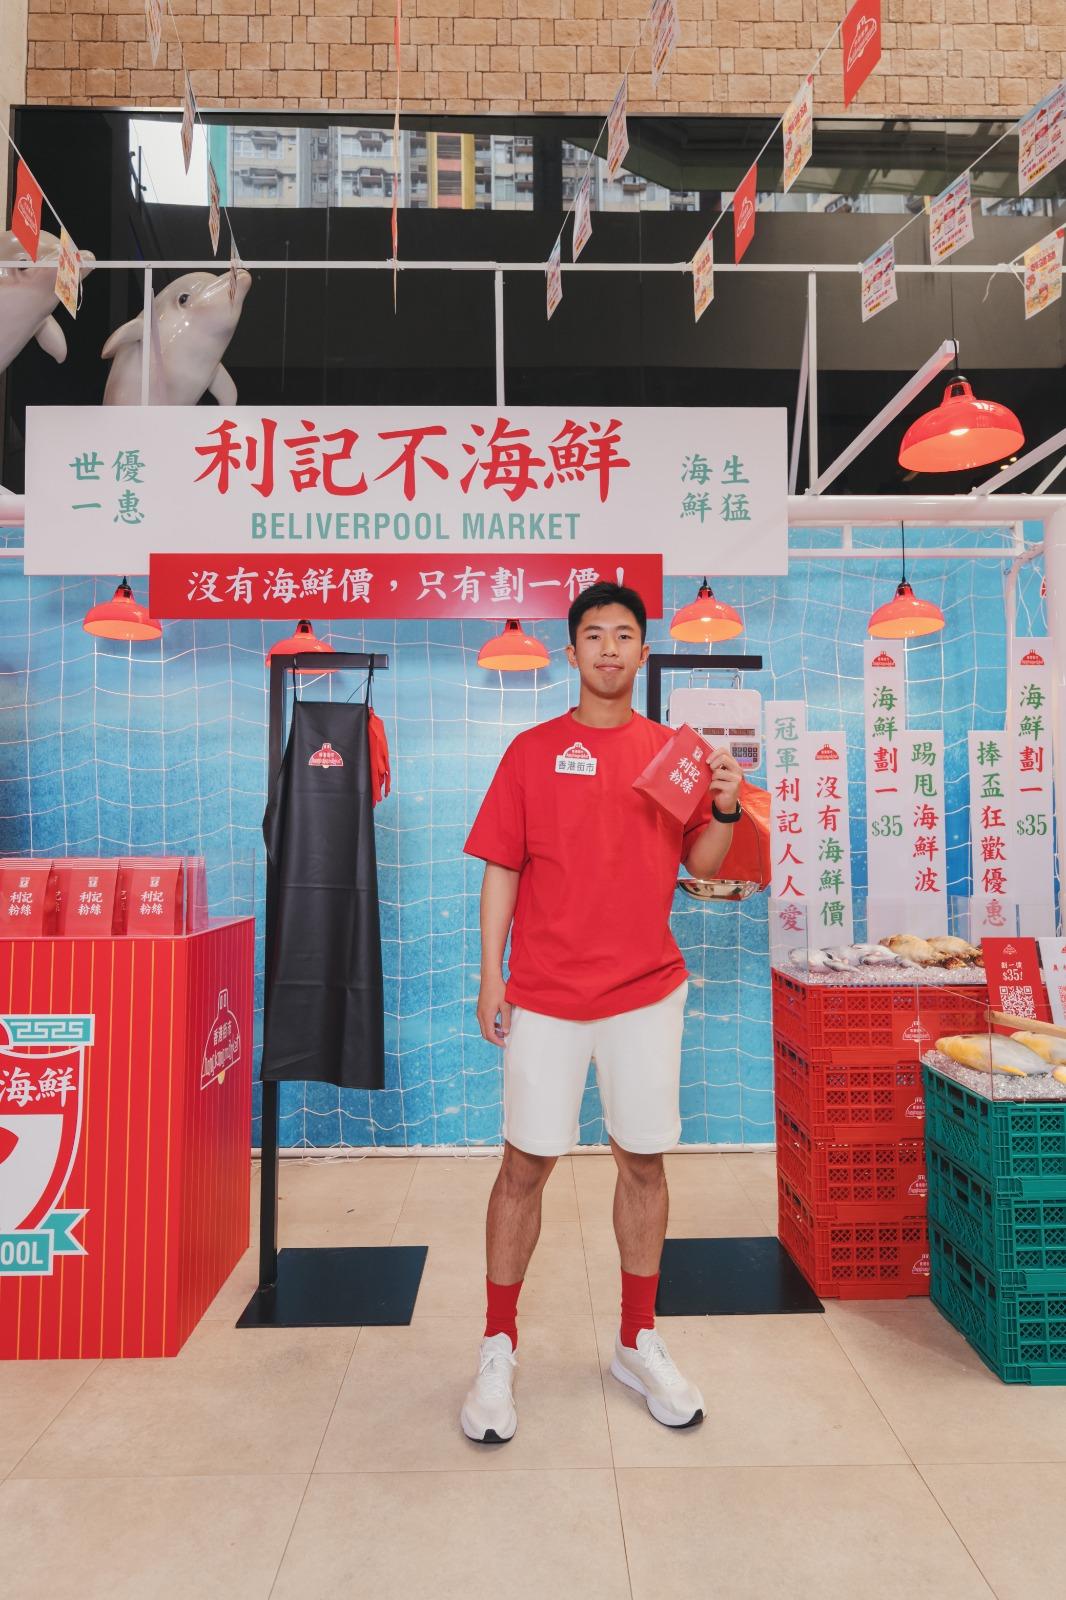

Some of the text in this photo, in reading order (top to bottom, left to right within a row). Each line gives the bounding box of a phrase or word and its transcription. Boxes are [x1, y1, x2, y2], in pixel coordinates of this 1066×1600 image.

[193, 416, 631, 503] 利記不海鮮
[251, 511, 581, 541] BELIVERPOOL MARKET
[871, 684, 899, 795] 海鮮劃一
[1018, 683, 1046, 795] 海鮮劃一
[773, 716, 805, 932] 冠軍利記人人愛
[815, 775, 845, 927] 沒有海鮮價
[871, 814, 903, 837] $35
[911, 742, 941, 893] 踢甩海鮮波
[977, 741, 1008, 928] 捧盃狂歡優惠
[1016, 814, 1048, 837] $35
[1002, 968, 1023, 981] $35!
